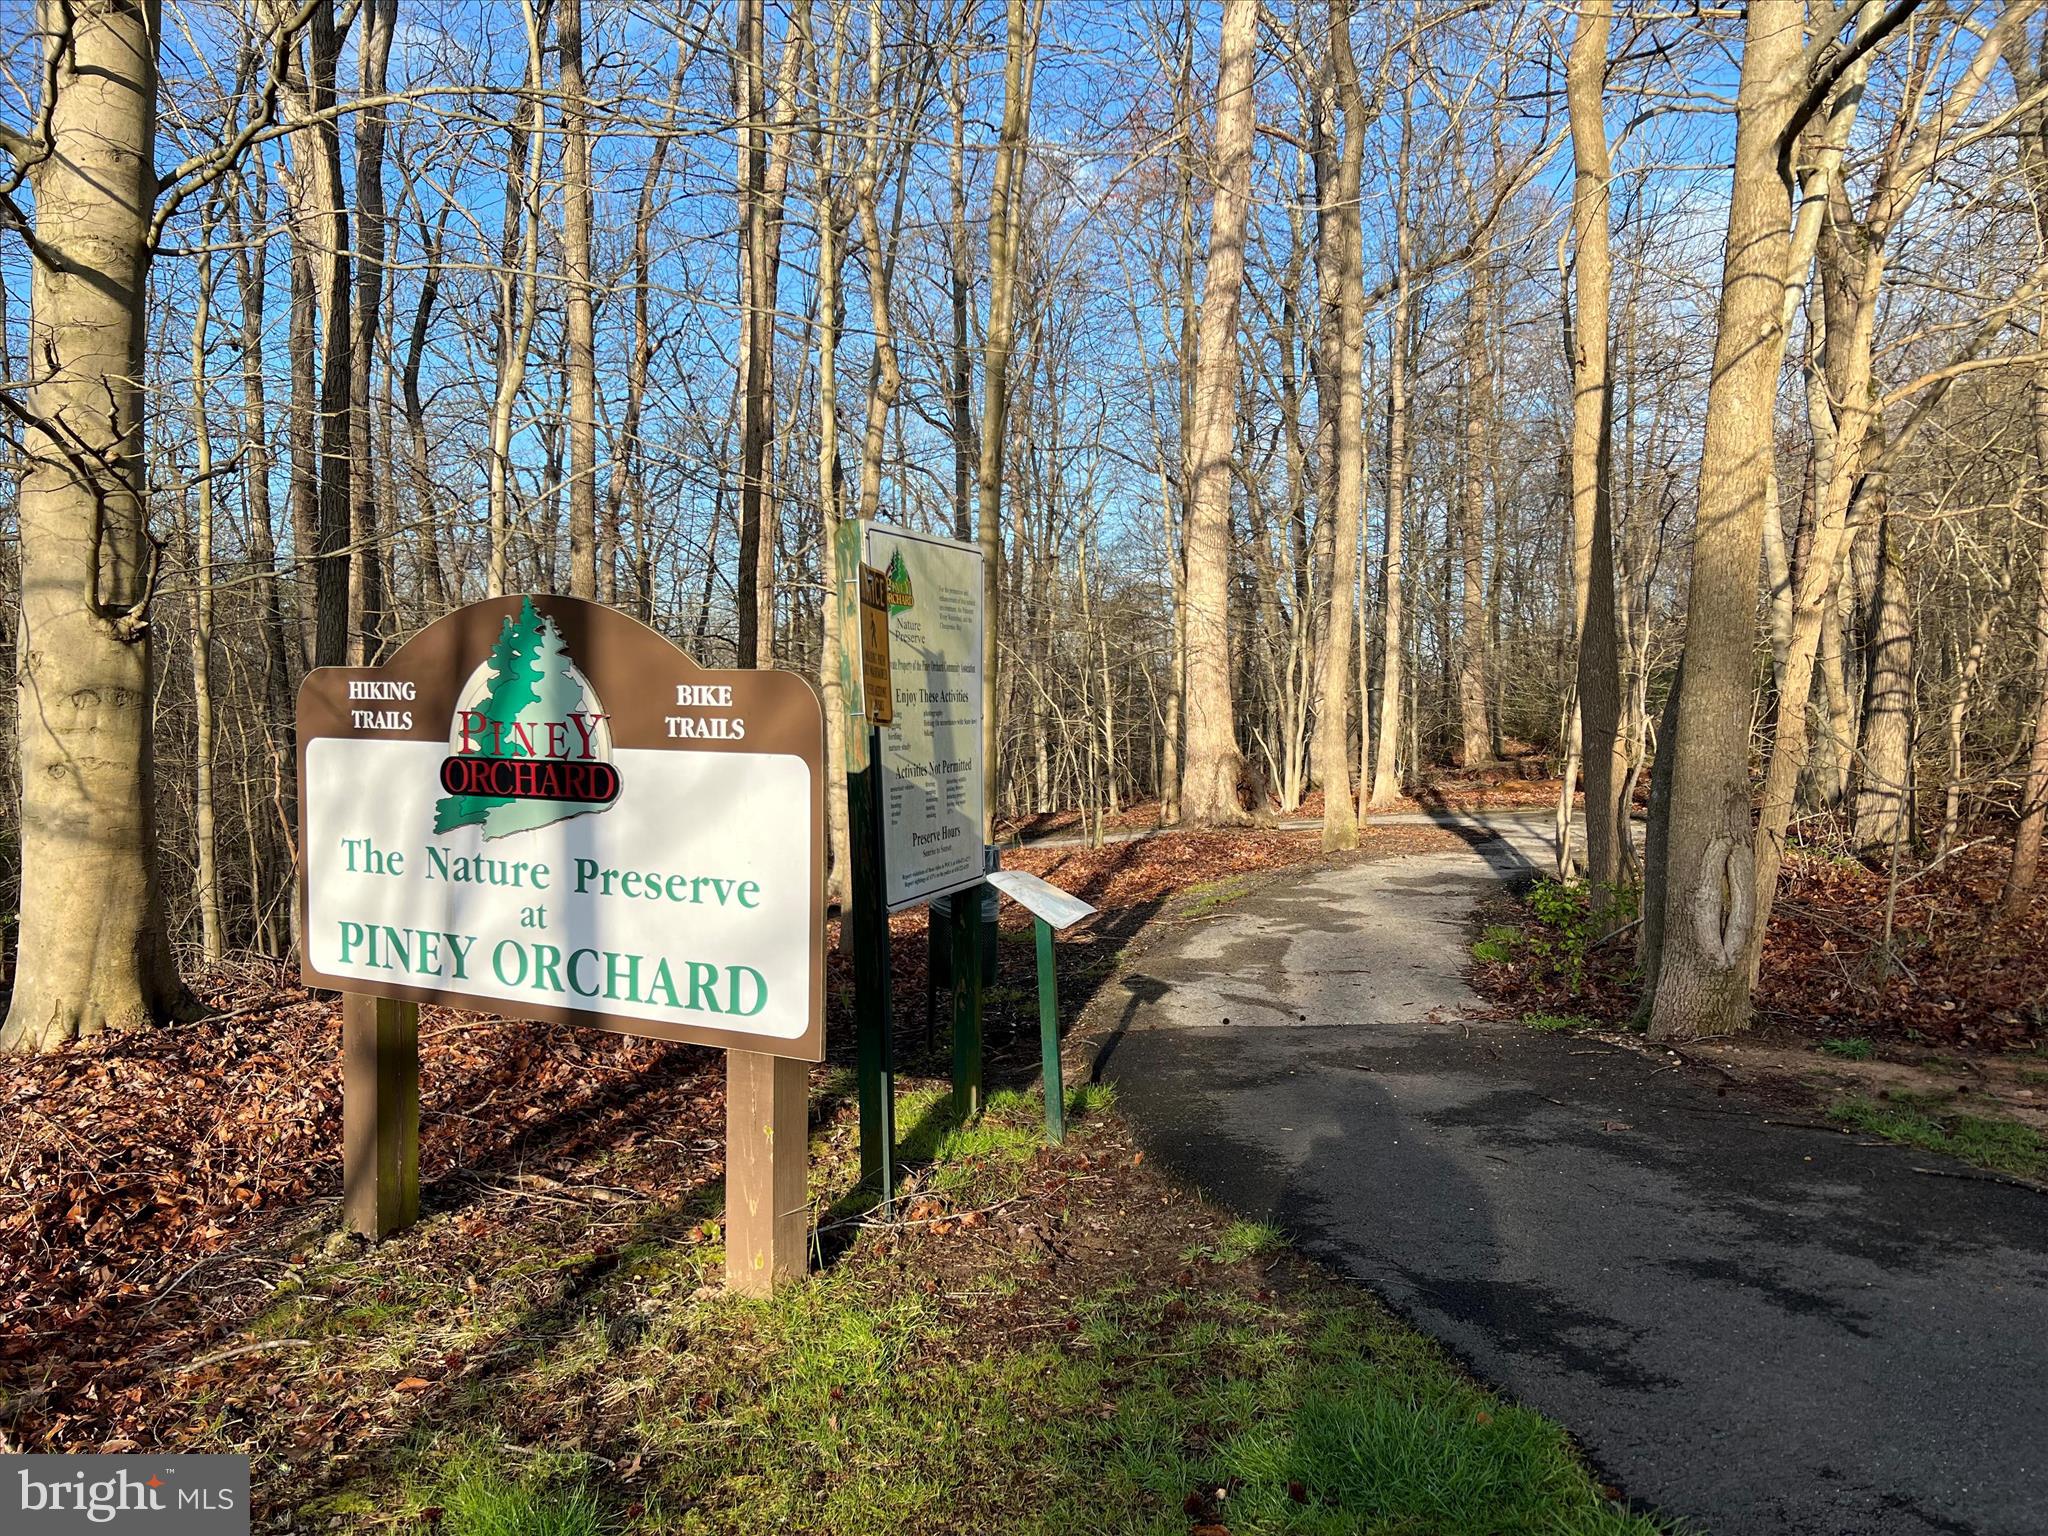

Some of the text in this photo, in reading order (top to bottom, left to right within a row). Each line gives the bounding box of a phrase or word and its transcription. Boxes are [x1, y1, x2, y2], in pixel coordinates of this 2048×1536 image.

[897, 617, 921, 631] Nature
[895, 629, 926, 644] Preserve
[349, 681, 416, 702] HIKING
[676, 684, 733, 708] BIKE
[896, 688, 917, 707] Enjoy
[919, 689, 938, 703] These
[941, 689, 969, 703] Activities
[352, 710, 413, 731] TRAILS
[665, 716, 745, 740] TRAILS
[456, 710, 611, 760] PINEY
[444, 758, 615, 801] ORCHARD
[896, 757, 972, 779] Activities Not Permitted
[912, 825, 961, 847] Preserve Hours
[341, 838, 761, 909] The Nature Preserve
[520, 902, 548, 929] at
[337, 921, 768, 1018] PINEY ORCHARD
